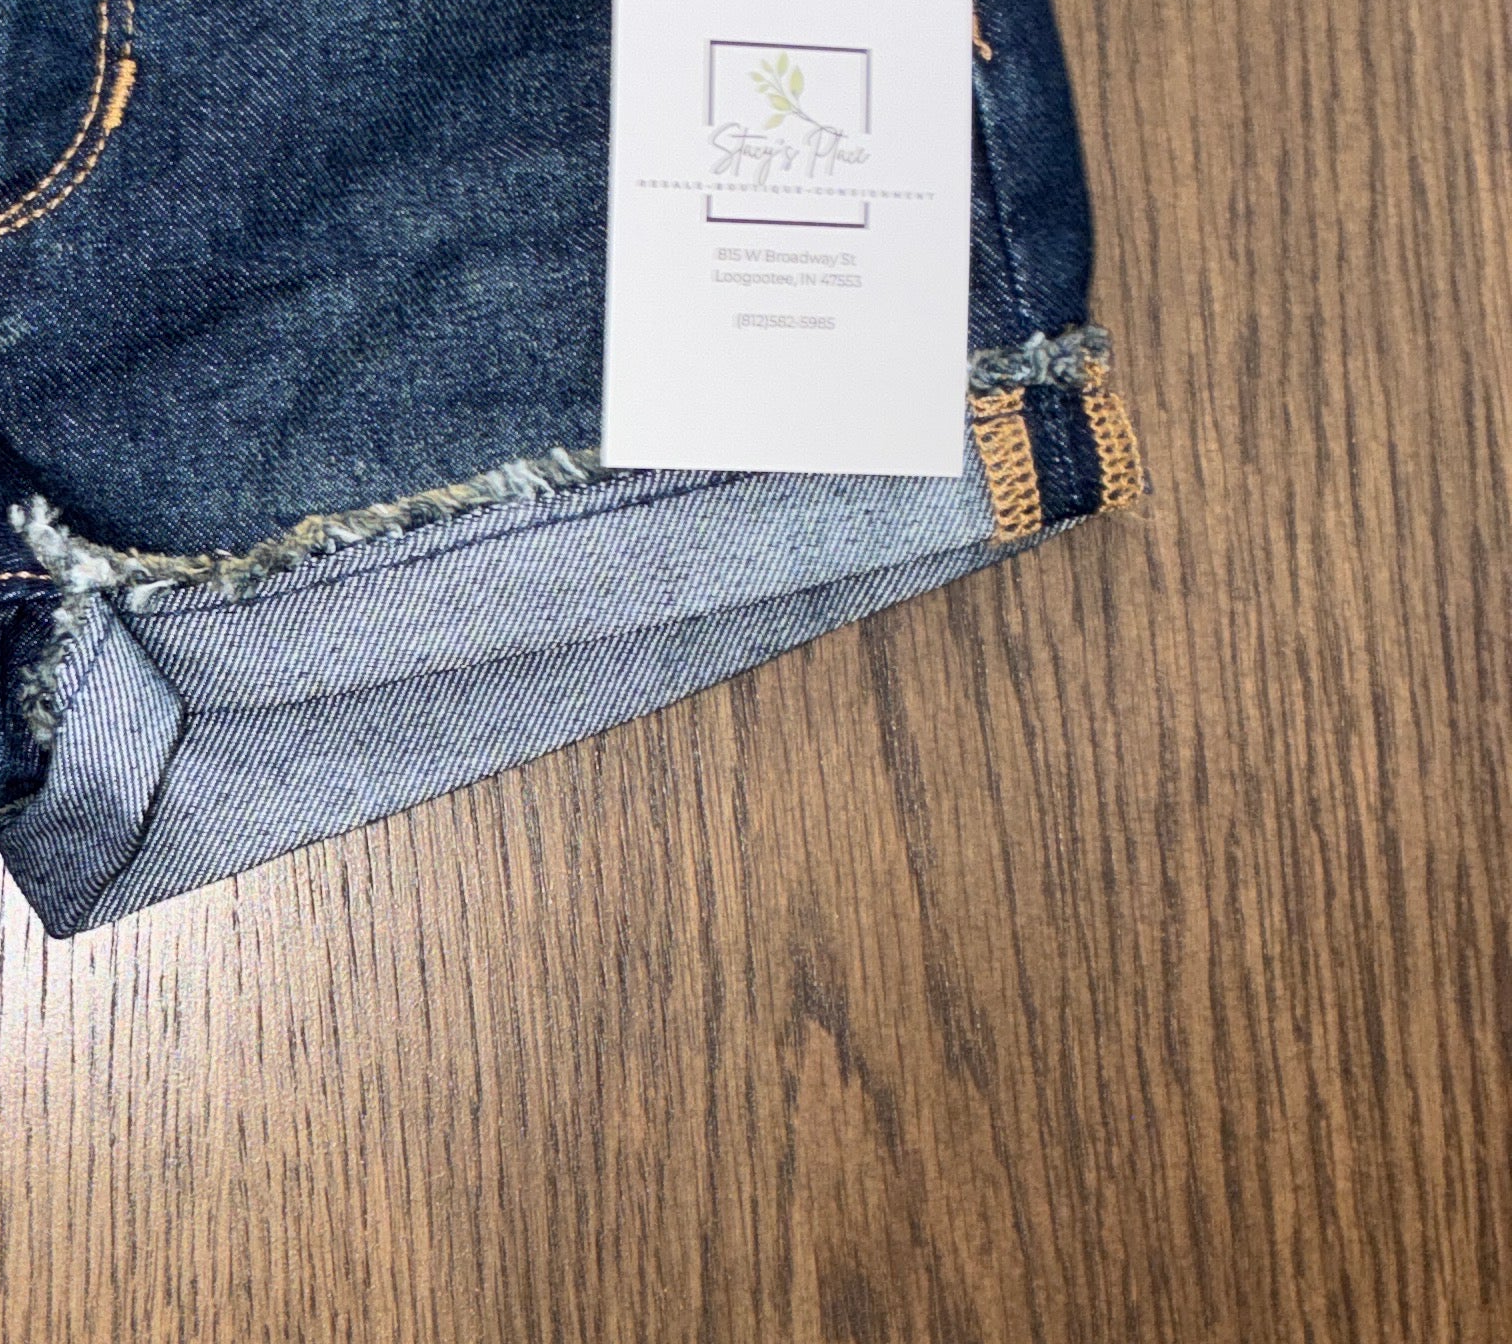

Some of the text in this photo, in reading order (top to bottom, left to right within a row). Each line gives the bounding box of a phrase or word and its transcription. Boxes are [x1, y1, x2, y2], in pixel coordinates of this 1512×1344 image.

[709, 122, 872, 186] Stacy's Place
[716, 247, 857, 268] 815 W Broadway St
[714, 268, 863, 288] Loogootee, IN 47553
